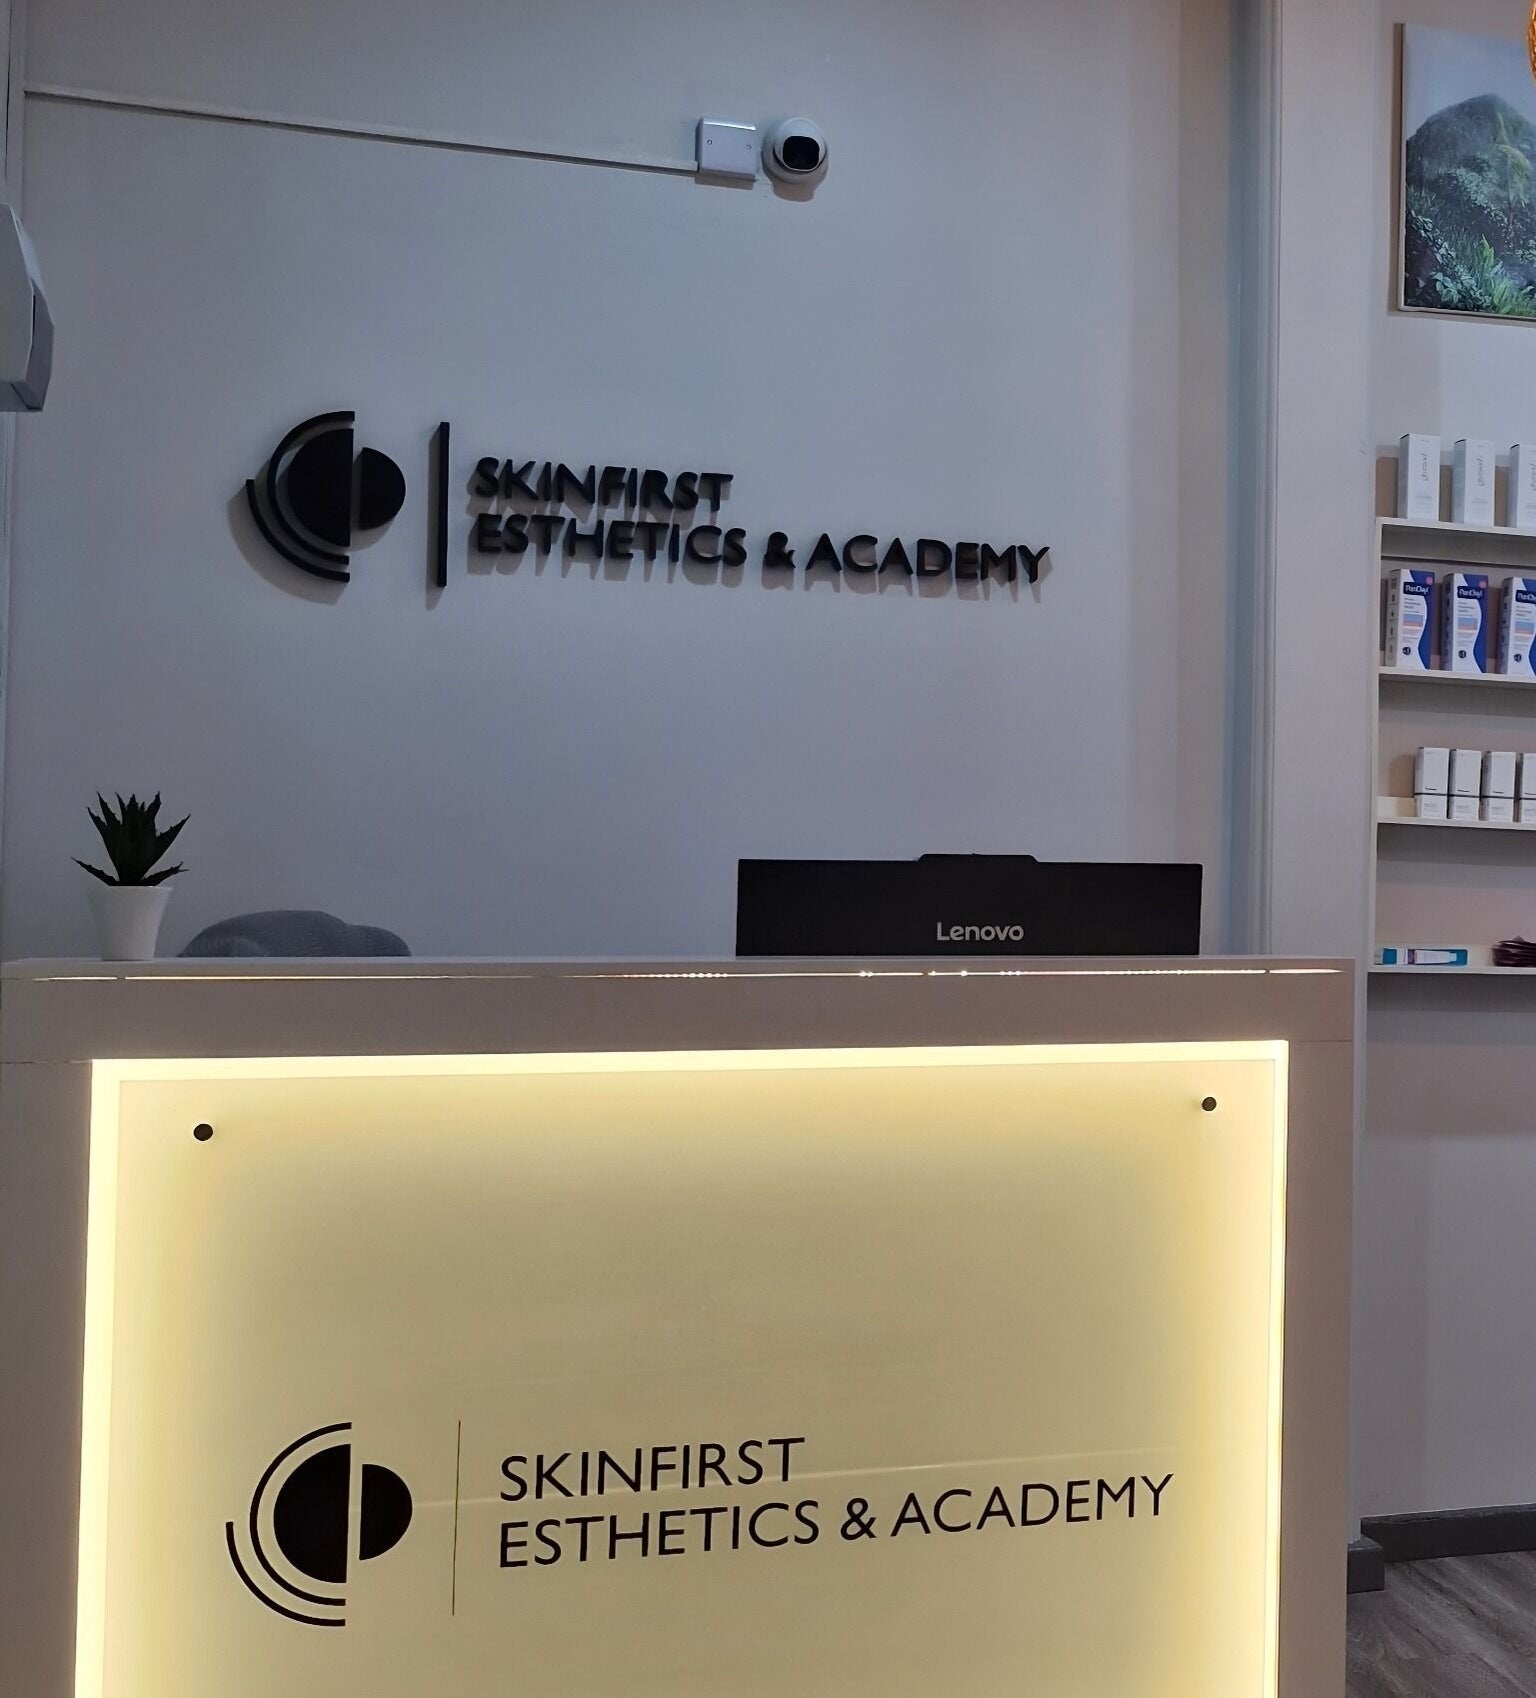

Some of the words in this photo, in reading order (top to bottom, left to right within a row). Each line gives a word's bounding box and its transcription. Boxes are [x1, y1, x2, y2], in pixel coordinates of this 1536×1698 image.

[475, 457, 733, 512] SKINFIRST
[477, 513, 747, 567] ESTHETICS
[763, 532, 796, 569] &
[806, 534, 1050, 584] ACADEMY
[936, 922, 1024, 941] Lenovo
[501, 1437, 805, 1501] SKINFIRST
[500, 1500, 819, 1568] ESTHETICS
[840, 1498, 877, 1540] &
[890, 1474, 1174, 1537] ACADEMY
